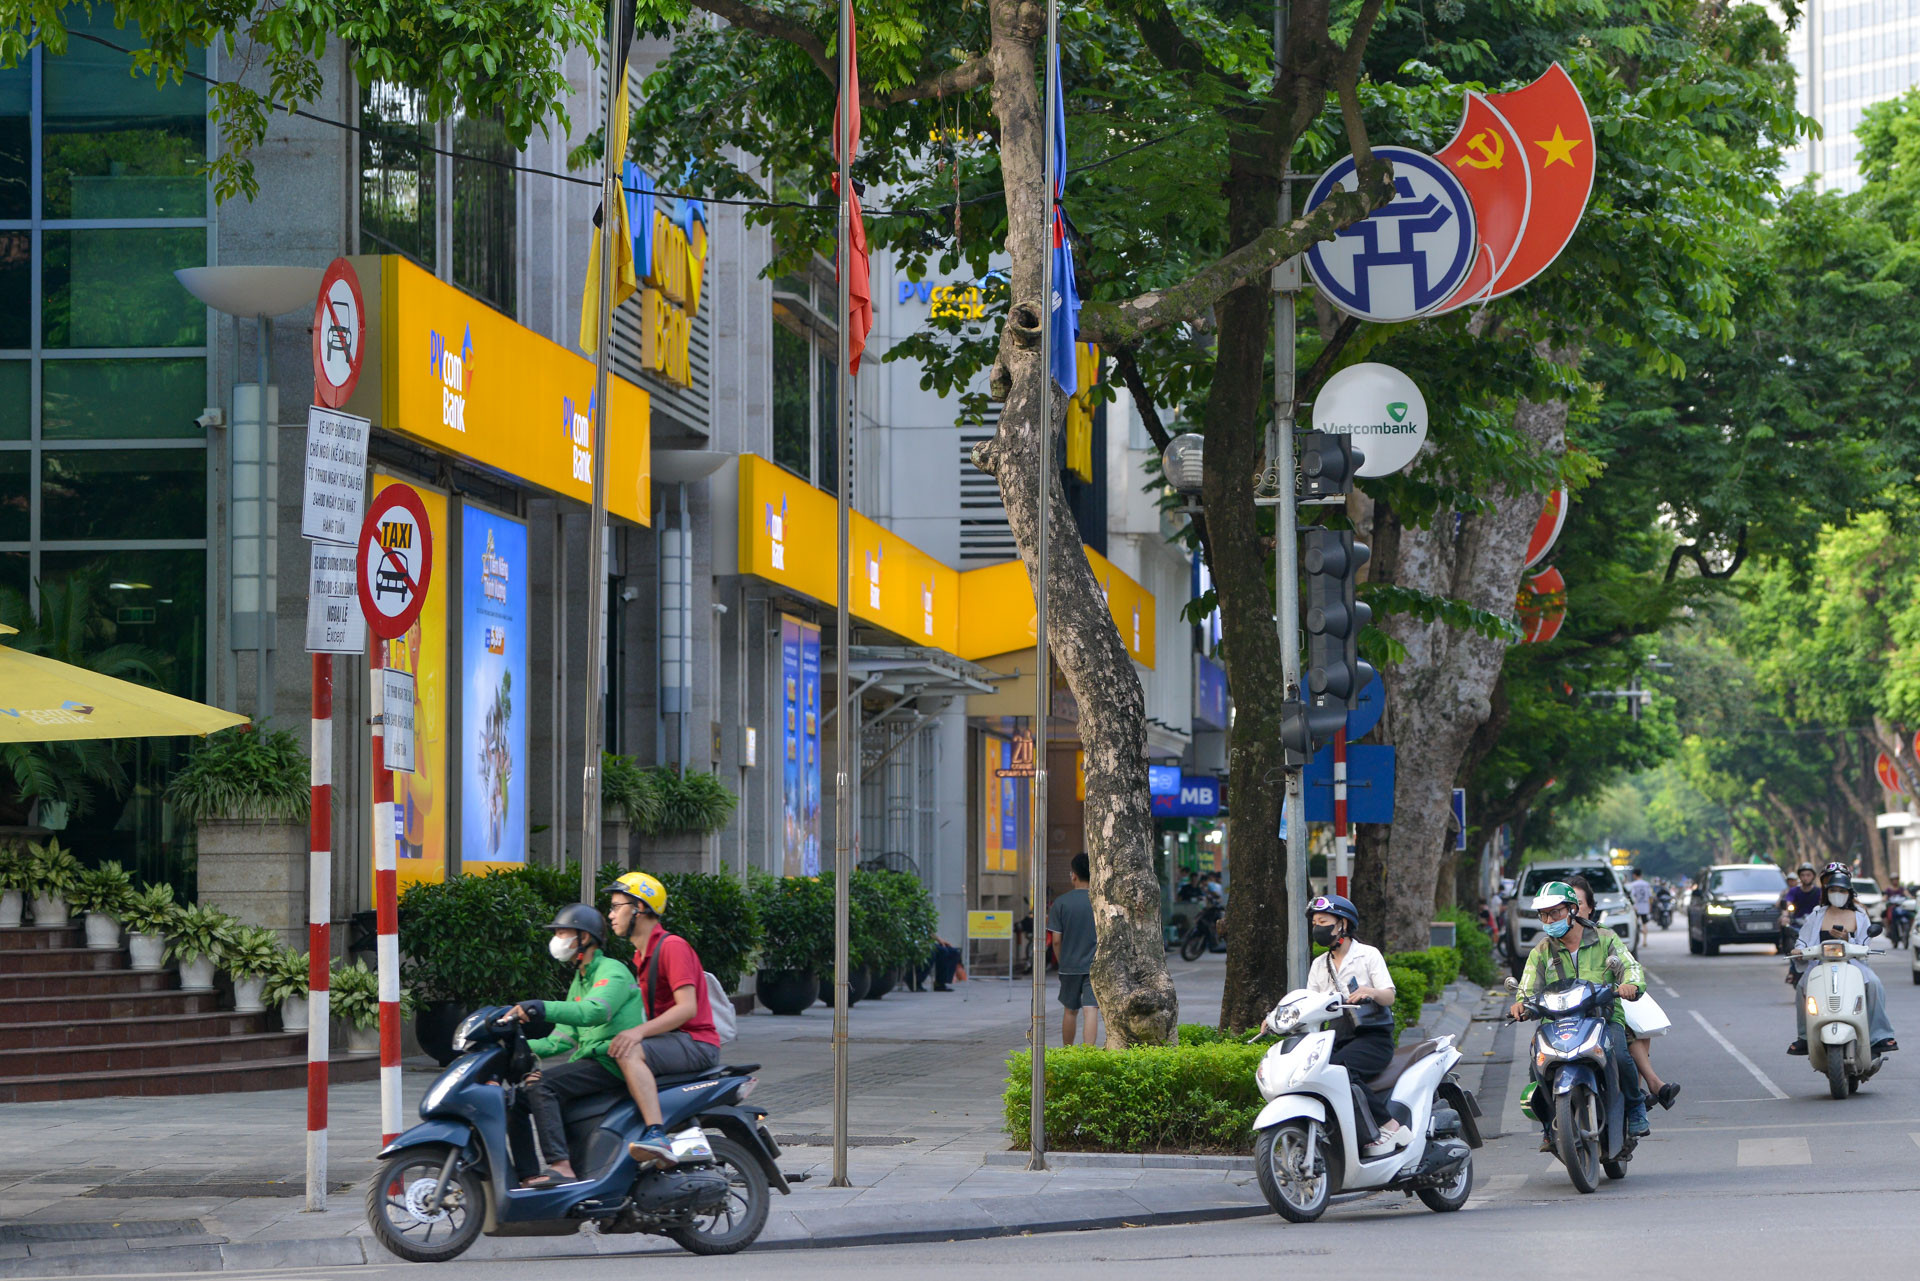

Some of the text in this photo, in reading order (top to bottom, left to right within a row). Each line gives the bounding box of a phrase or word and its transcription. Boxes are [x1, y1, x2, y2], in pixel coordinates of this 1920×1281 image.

[622, 160, 687, 301] PVcom
[641, 289, 693, 390] Bank
[430, 329, 462, 391] PVcom
[443, 387, 466, 433] Bank
[563, 395, 589, 448] PVcom
[1322, 421, 1418, 435] Vietcombank
[573, 445, 592, 484] Bank
[382, 521, 412, 549] TAXI
[326, 627, 345, 646] Except
[1180, 787, 1214, 805] MB
[639, 881, 656, 898] be
